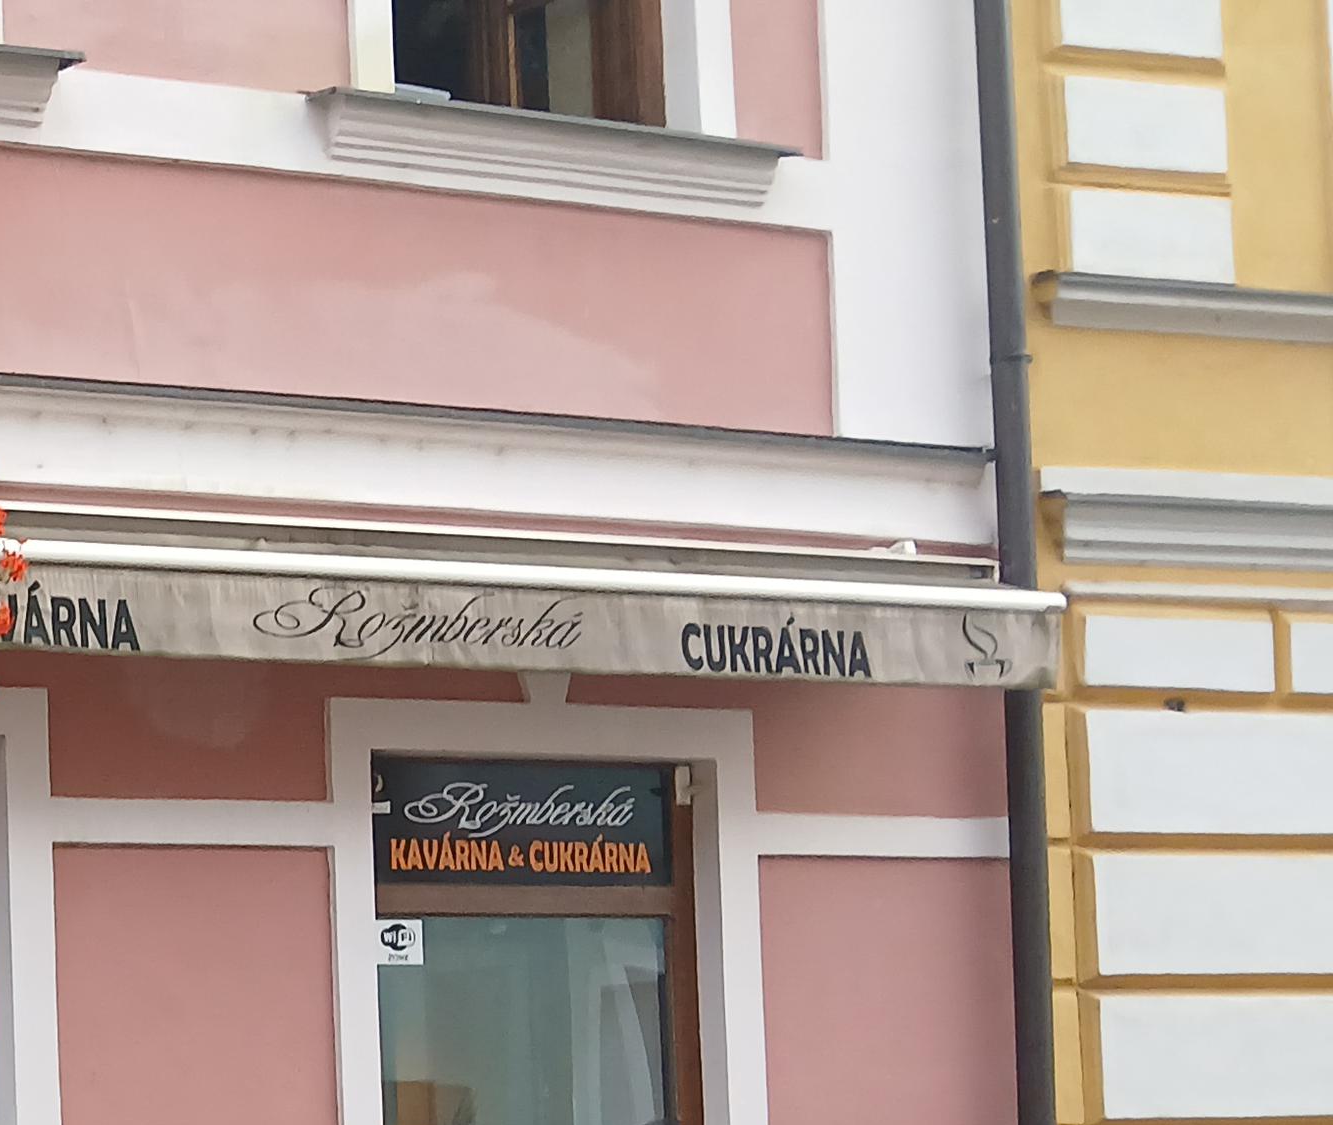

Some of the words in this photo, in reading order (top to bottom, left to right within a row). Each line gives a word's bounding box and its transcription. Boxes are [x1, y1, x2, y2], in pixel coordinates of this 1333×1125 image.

[253, 586, 585, 662] Rožmberská
[681, 614, 872, 679] CUKRÁRNA
[404, 781, 635, 838] Rožmberská
[390, 831, 505, 872] KAVÁRNA
[507, 844, 525, 868] &
[529, 833, 652, 874] CUKRÁRNA
